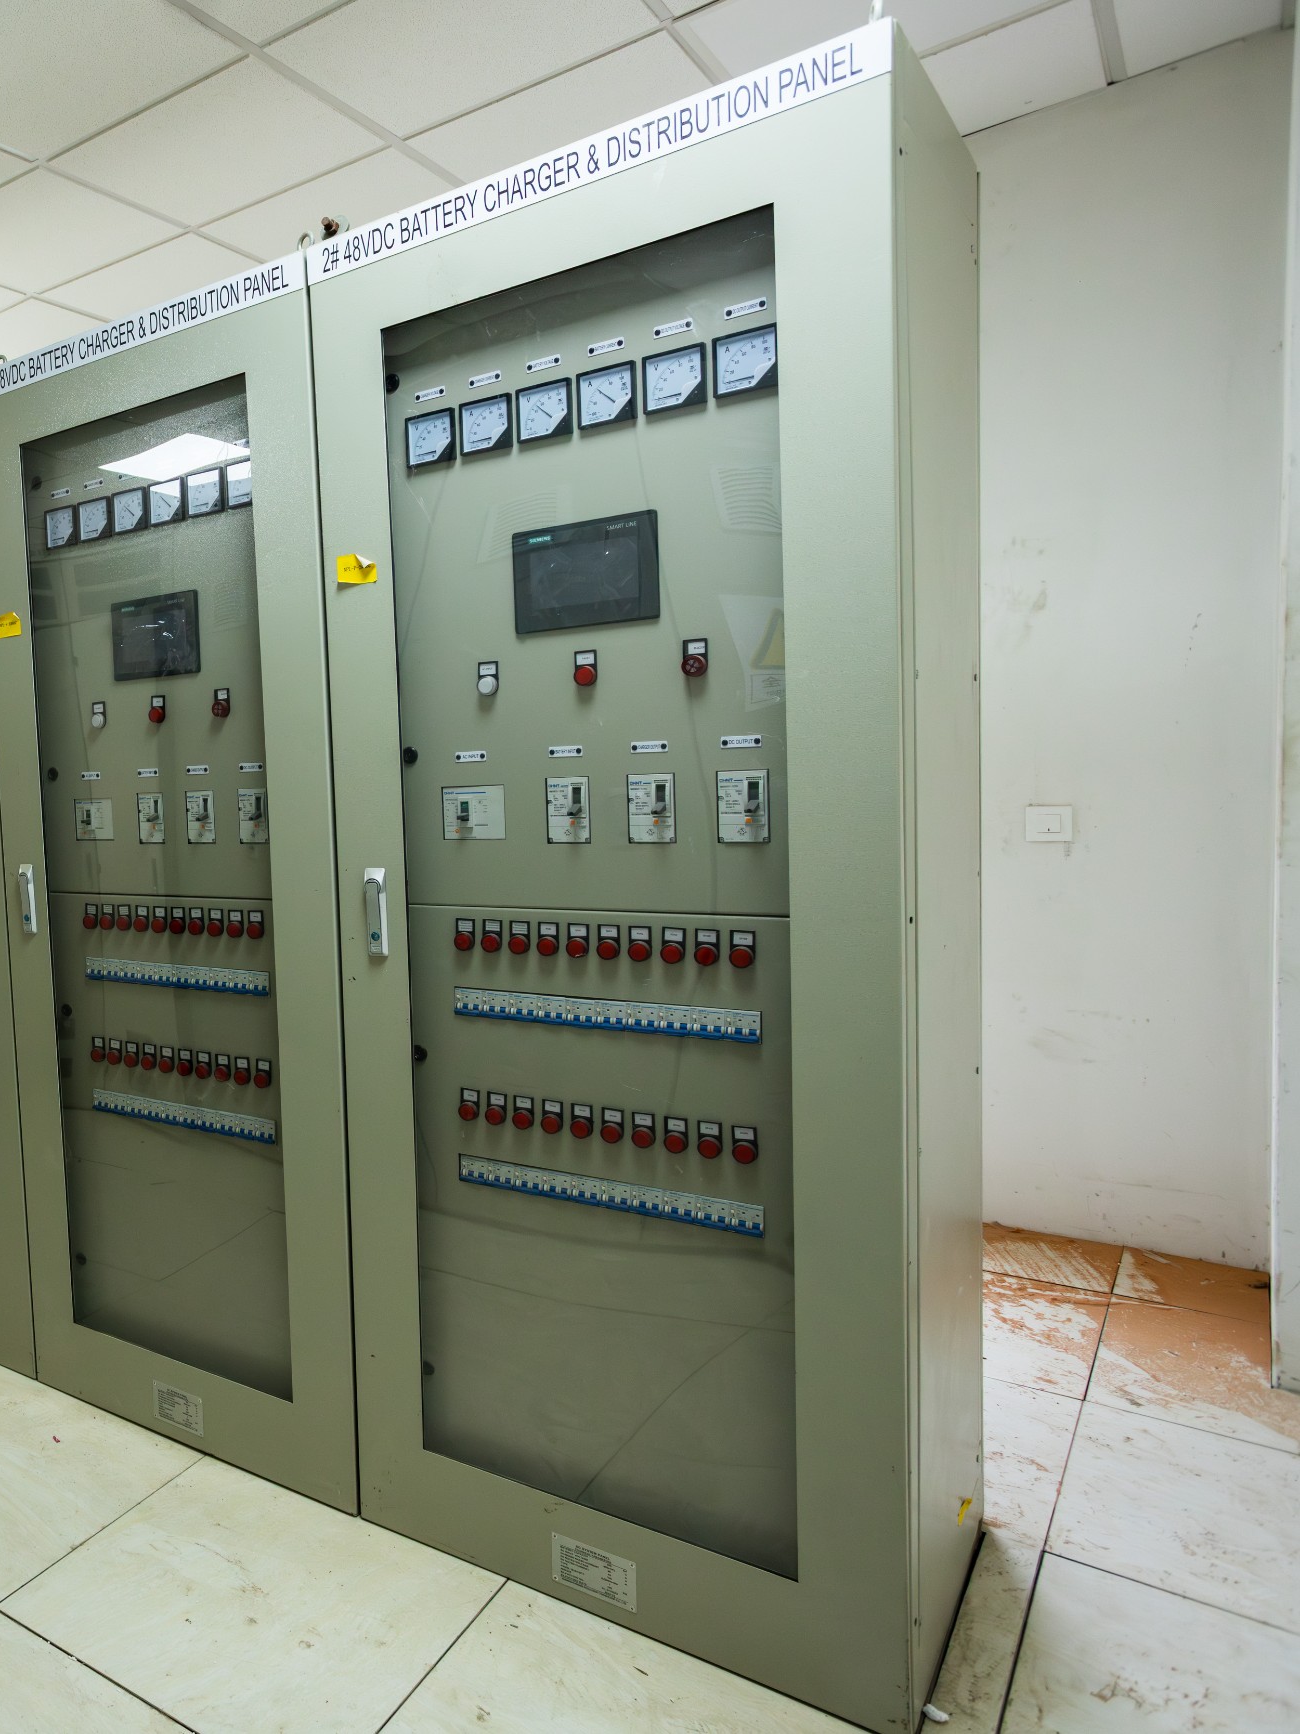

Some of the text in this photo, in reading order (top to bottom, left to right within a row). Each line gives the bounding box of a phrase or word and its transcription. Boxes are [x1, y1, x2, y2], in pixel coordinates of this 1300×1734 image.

[321, 41, 864, 275] 2# 48VDC BATTERY CHARGER & DISTRIBUTION PANEL
[28, 341, 76, 380] BATTERY
[79, 319, 136, 361] CHARGER
[138, 315, 147, 338] &
[149, 280, 241, 336] DISTRIBUTION
[243, 264, 290, 302] PANEL
[606, 522, 624, 531] SMART
